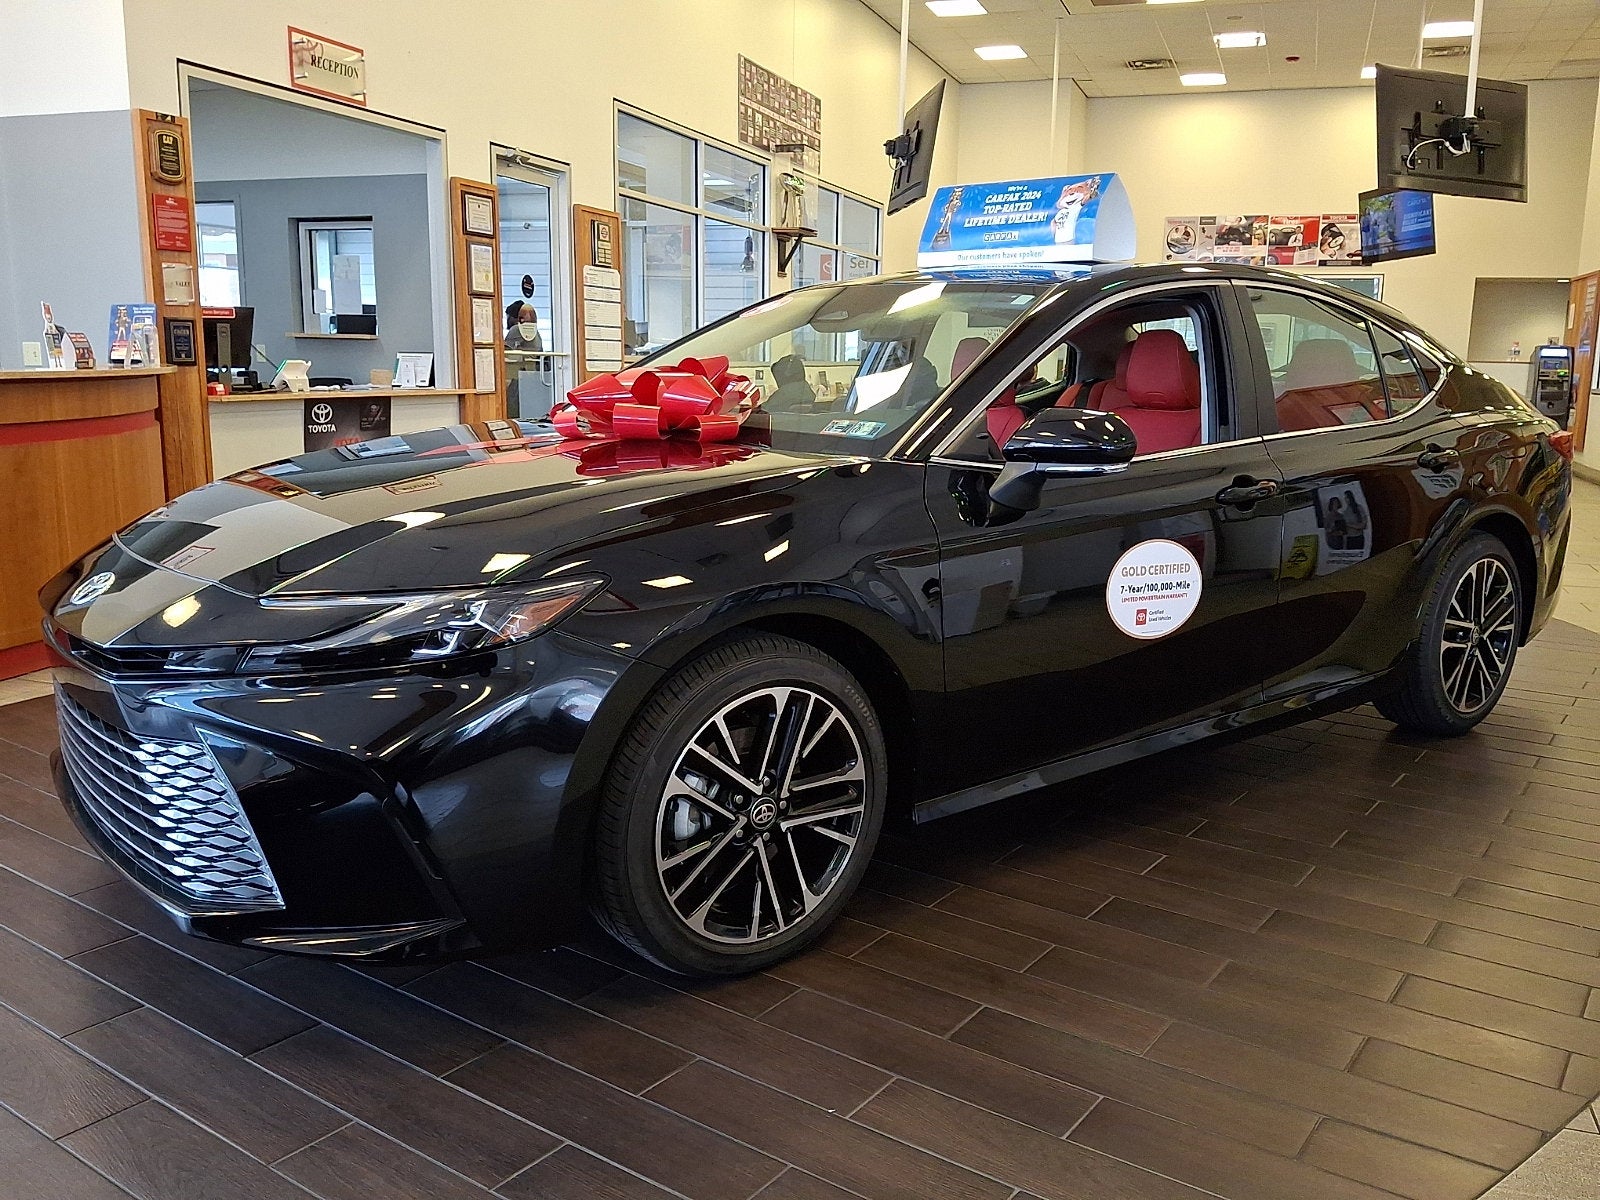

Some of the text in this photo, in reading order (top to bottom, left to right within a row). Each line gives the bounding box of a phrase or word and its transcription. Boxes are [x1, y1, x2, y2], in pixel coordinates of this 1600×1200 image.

[310, 54, 359, 79] RECEPTION
[985, 190, 1042, 204] CARFAX 2024
[983, 202, 1032, 214] TOP-RATED
[964, 215, 1007, 227] LIFETIME
[1007, 212, 1048, 224] DEALER!
[984, 232, 1019, 242] CARFAX
[969, 253, 1001, 261] customers
[1002, 251, 1017, 259] have
[1019, 249, 1045, 260] spoken!
[308, 423, 337, 434] TOYOTA
[1121, 563, 1191, 577] GOLD CERTIFIED
[1120, 580, 1190, 594] 7-Year/100,000-Mile
[1121, 596, 1138, 604] LIMITED
